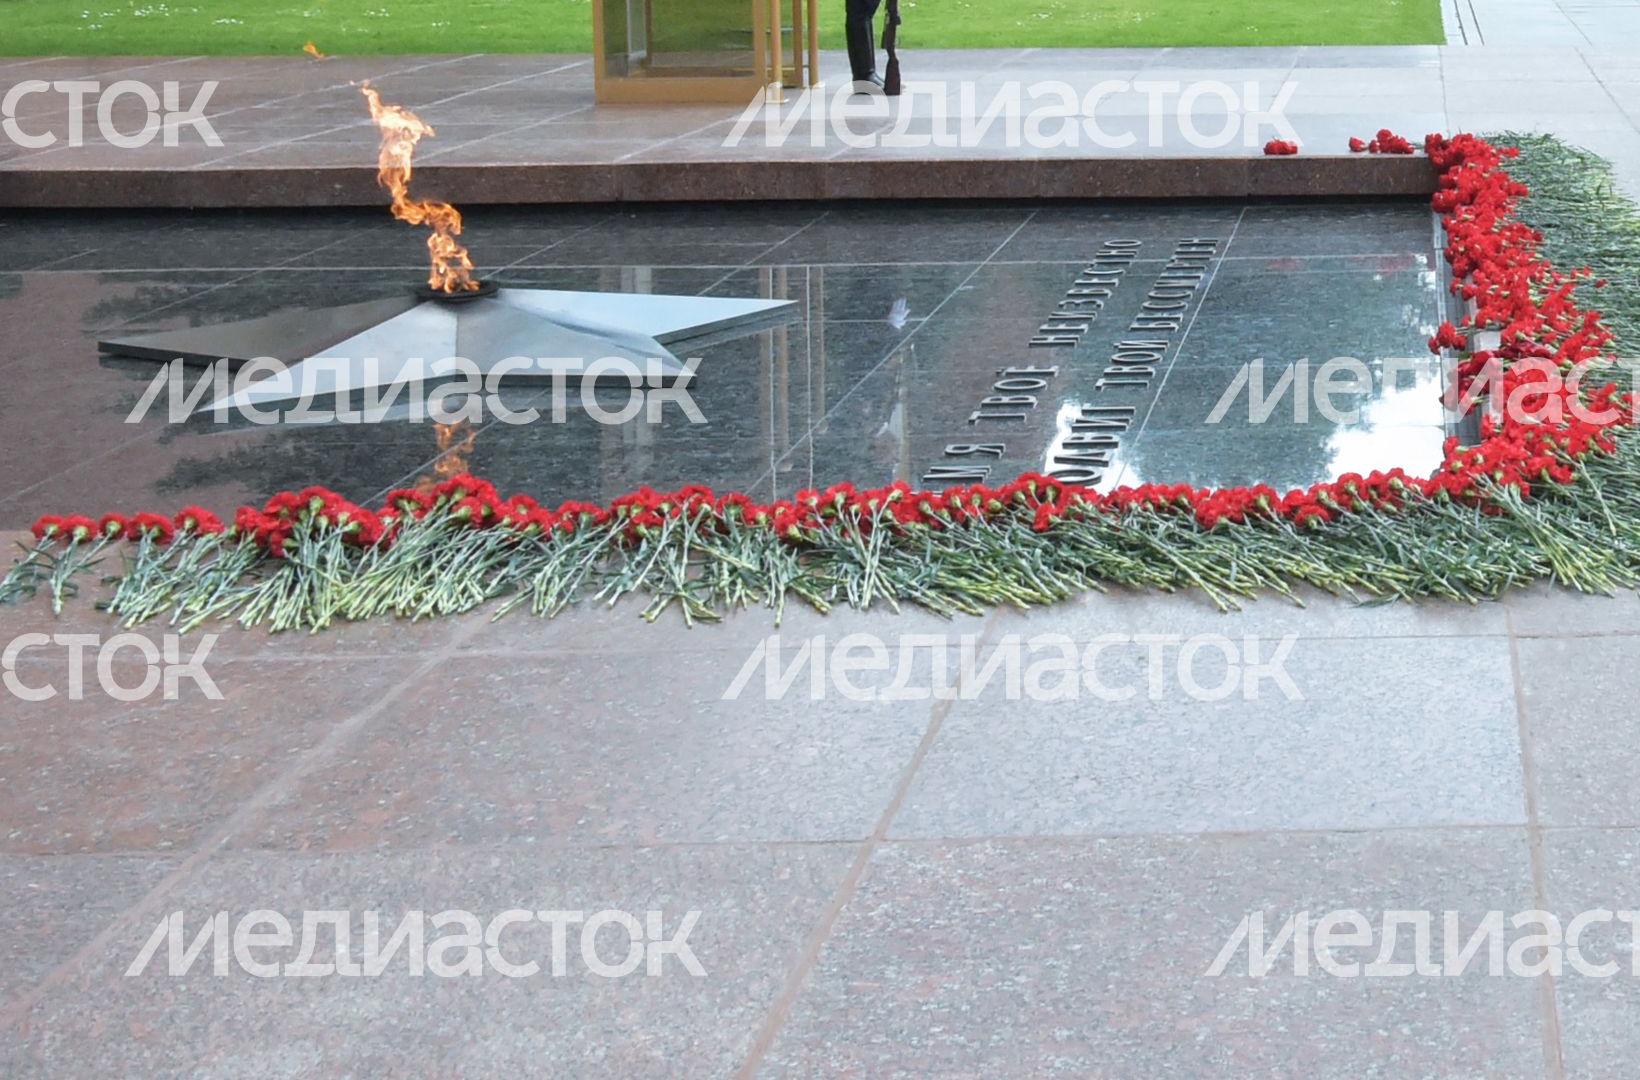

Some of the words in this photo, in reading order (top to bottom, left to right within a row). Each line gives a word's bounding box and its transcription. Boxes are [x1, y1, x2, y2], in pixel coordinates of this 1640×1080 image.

[922, 442, 1006, 483] МЯ
[1028, 239, 1143, 348] НЕИЗВЕСТНО
[1046, 405, 1137, 487] ОДВИГ
[1128, 238, 1219, 332] БЕССМЕРТЕН
